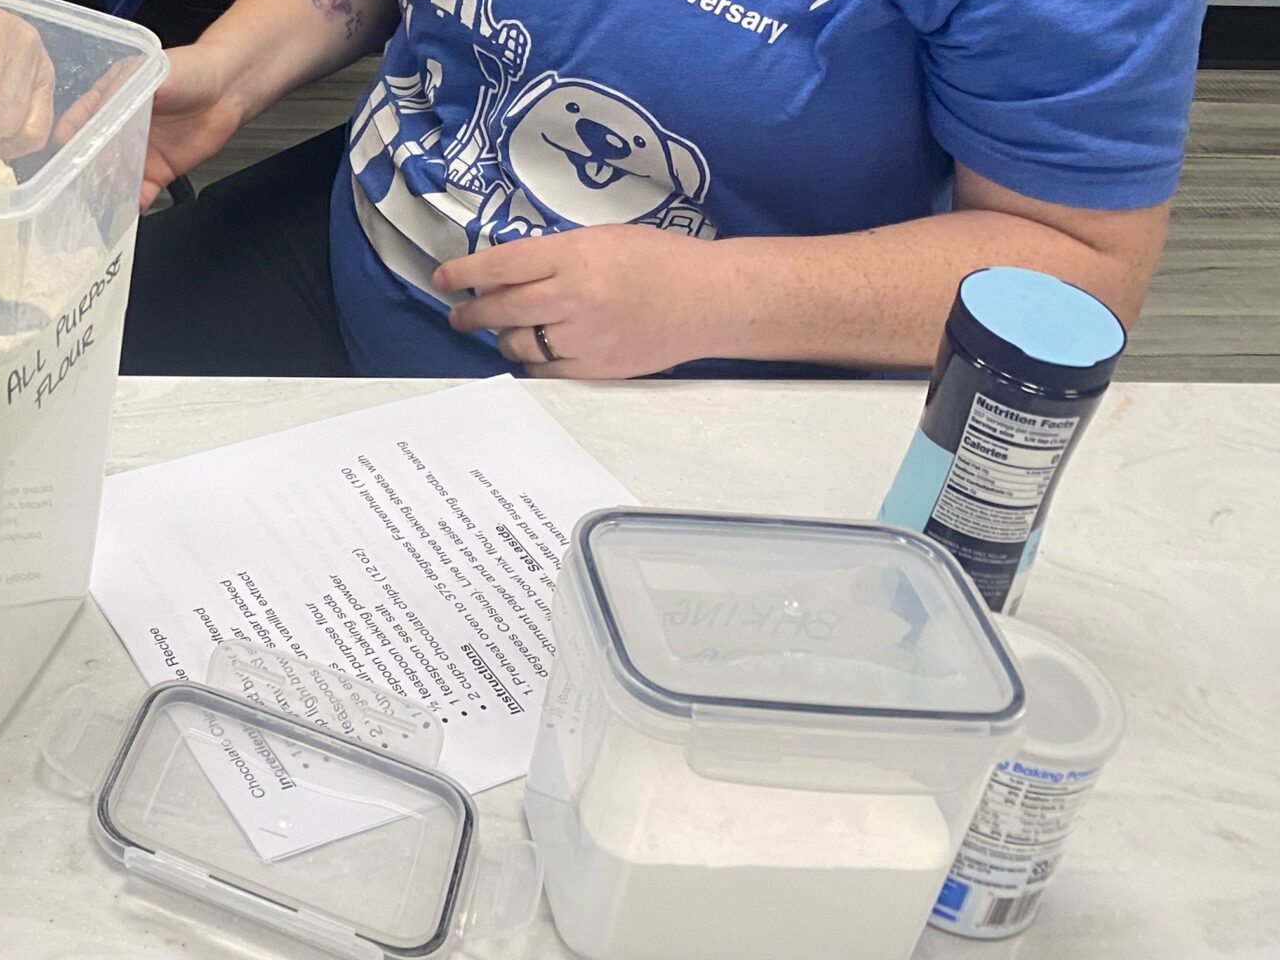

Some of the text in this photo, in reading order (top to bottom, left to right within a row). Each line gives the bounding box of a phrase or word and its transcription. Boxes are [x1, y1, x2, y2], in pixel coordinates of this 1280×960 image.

[7, 252, 123, 405] ALL PURPOSE
[35, 324, 95, 409] FLOUR
[976, 396, 1037, 426] Nutrition
[396, 440, 426, 470] baking
[962, 436, 1008, 461] Calories
[340, 467, 365, 488] (190
[425, 470, 448, 496] soda,
[468, 468, 492, 488] until
[359, 489, 405, 540] Fahrenheit
[445, 497, 476, 530] baking
[489, 488, 521, 520] sugars
[518, 492, 569, 546] hand mixer.
[437, 517, 463, 545] aside.
[474, 529, 498, 555] flour,
[495, 523, 527, 553] aside.
[515, 521, 539, 540] and
[357, 454, 548, 677] degrees Celsius). Line three baking sheets with
[401, 541, 438, 581] degrees
[458, 546, 478, 563] set
[494, 555, 515, 573] mix
[519, 552, 544, 572] Set
[471, 563, 496, 582] and
[509, 574, 537, 598] bowl
[219, 579, 256, 618] packed
[236, 571, 268, 606] extract
[328, 574, 365, 611] powder
[433, 581, 457, 601] 375
[491, 584, 525, 612] paper
[304, 602, 328, 625] flour
[322, 593, 347, 619] soda
[373, 603, 395, 622] salt
[453, 601, 467, 613] to
[248, 620, 276, 648] sugar
[264, 607, 293, 642] vanilla
[342, 619, 375, 656] baking
[351, 547, 481, 700] 2 cups chocolate chips (12 oz)
[359, 611, 391, 647] baking
[392, 623, 412, 643] sea
[463, 613, 489, 640] oven
[149, 627, 179, 667] Recipe
[276, 656, 301, 685] brow
[388, 647, 431, 699] teaspoon
[409, 644, 453, 696] teaspoon
[460, 643, 524, 714] Instructions
[309, 668, 354, 734] teaspoons
[245, 724, 297, 790] Ingredient
[1013, 762, 1064, 783] Baking
